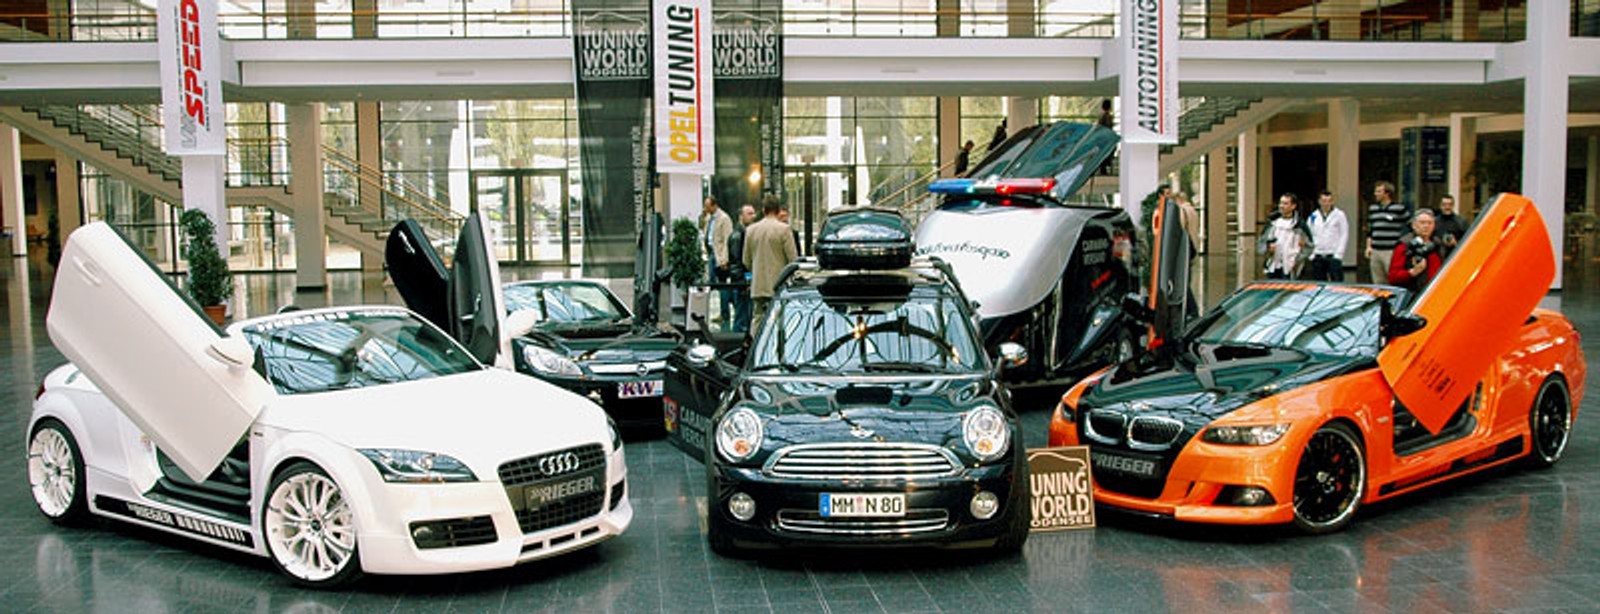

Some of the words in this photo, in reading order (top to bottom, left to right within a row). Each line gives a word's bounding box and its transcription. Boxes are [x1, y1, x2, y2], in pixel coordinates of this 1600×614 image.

[583, 31, 647, 49] TUNING
[714, 29, 776, 48] TUNING
[180, 0, 205, 126] SPEED
[583, 50, 647, 68] WORLD
[714, 49, 776, 68] WORLD
[1138, 0, 1159, 133] AUTOTUNING
[1096, 454, 1155, 475] RIEGER
[1030, 472, 1087, 496] UNING
[1030, 515, 1091, 527] ODENSEE
